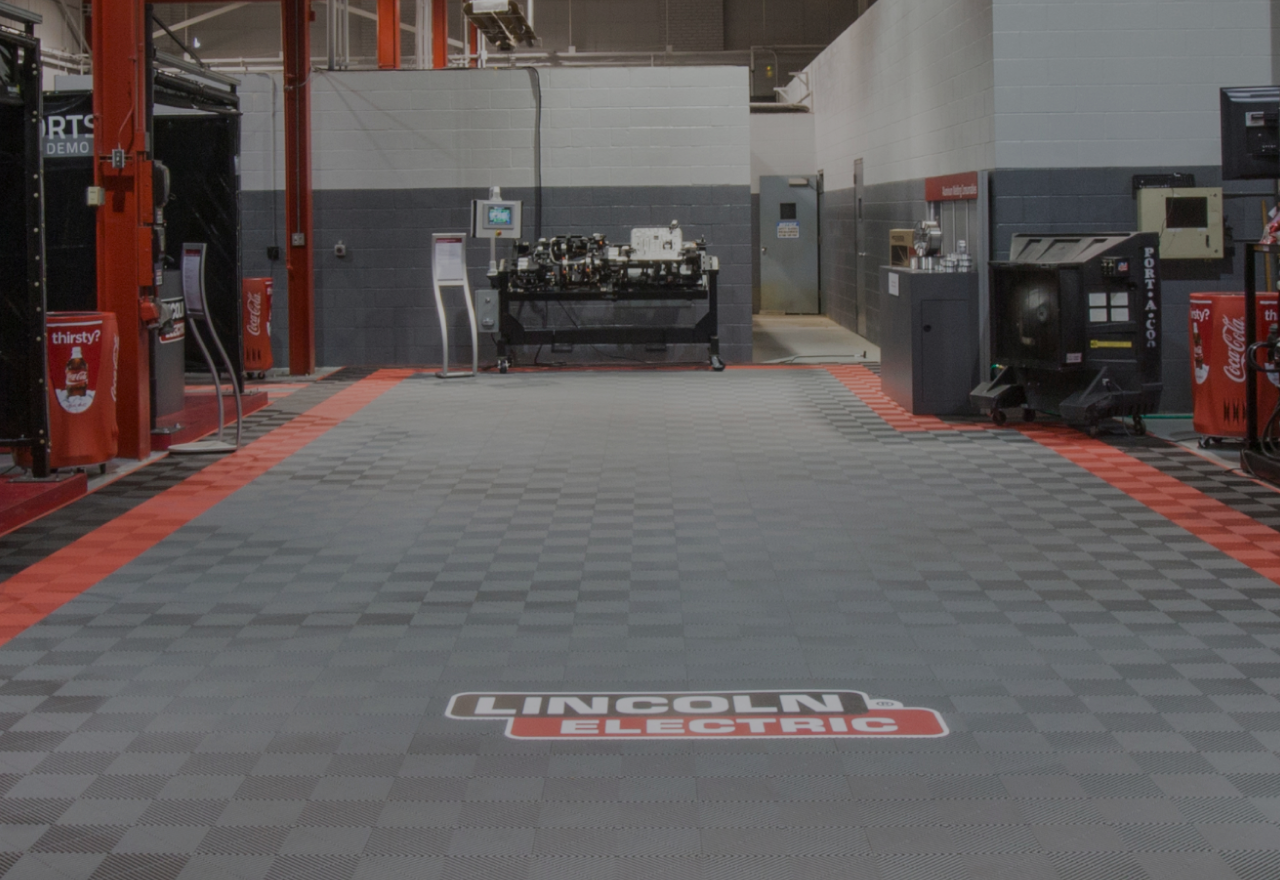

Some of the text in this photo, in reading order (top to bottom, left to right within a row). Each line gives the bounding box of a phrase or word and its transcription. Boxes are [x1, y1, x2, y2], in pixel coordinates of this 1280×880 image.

[47, 141, 89, 154] DEMO
[52, 330, 101, 345] thirsty?
[474, 694, 845, 716] LINCOLN
[560, 717, 900, 735] ELECTRIC
